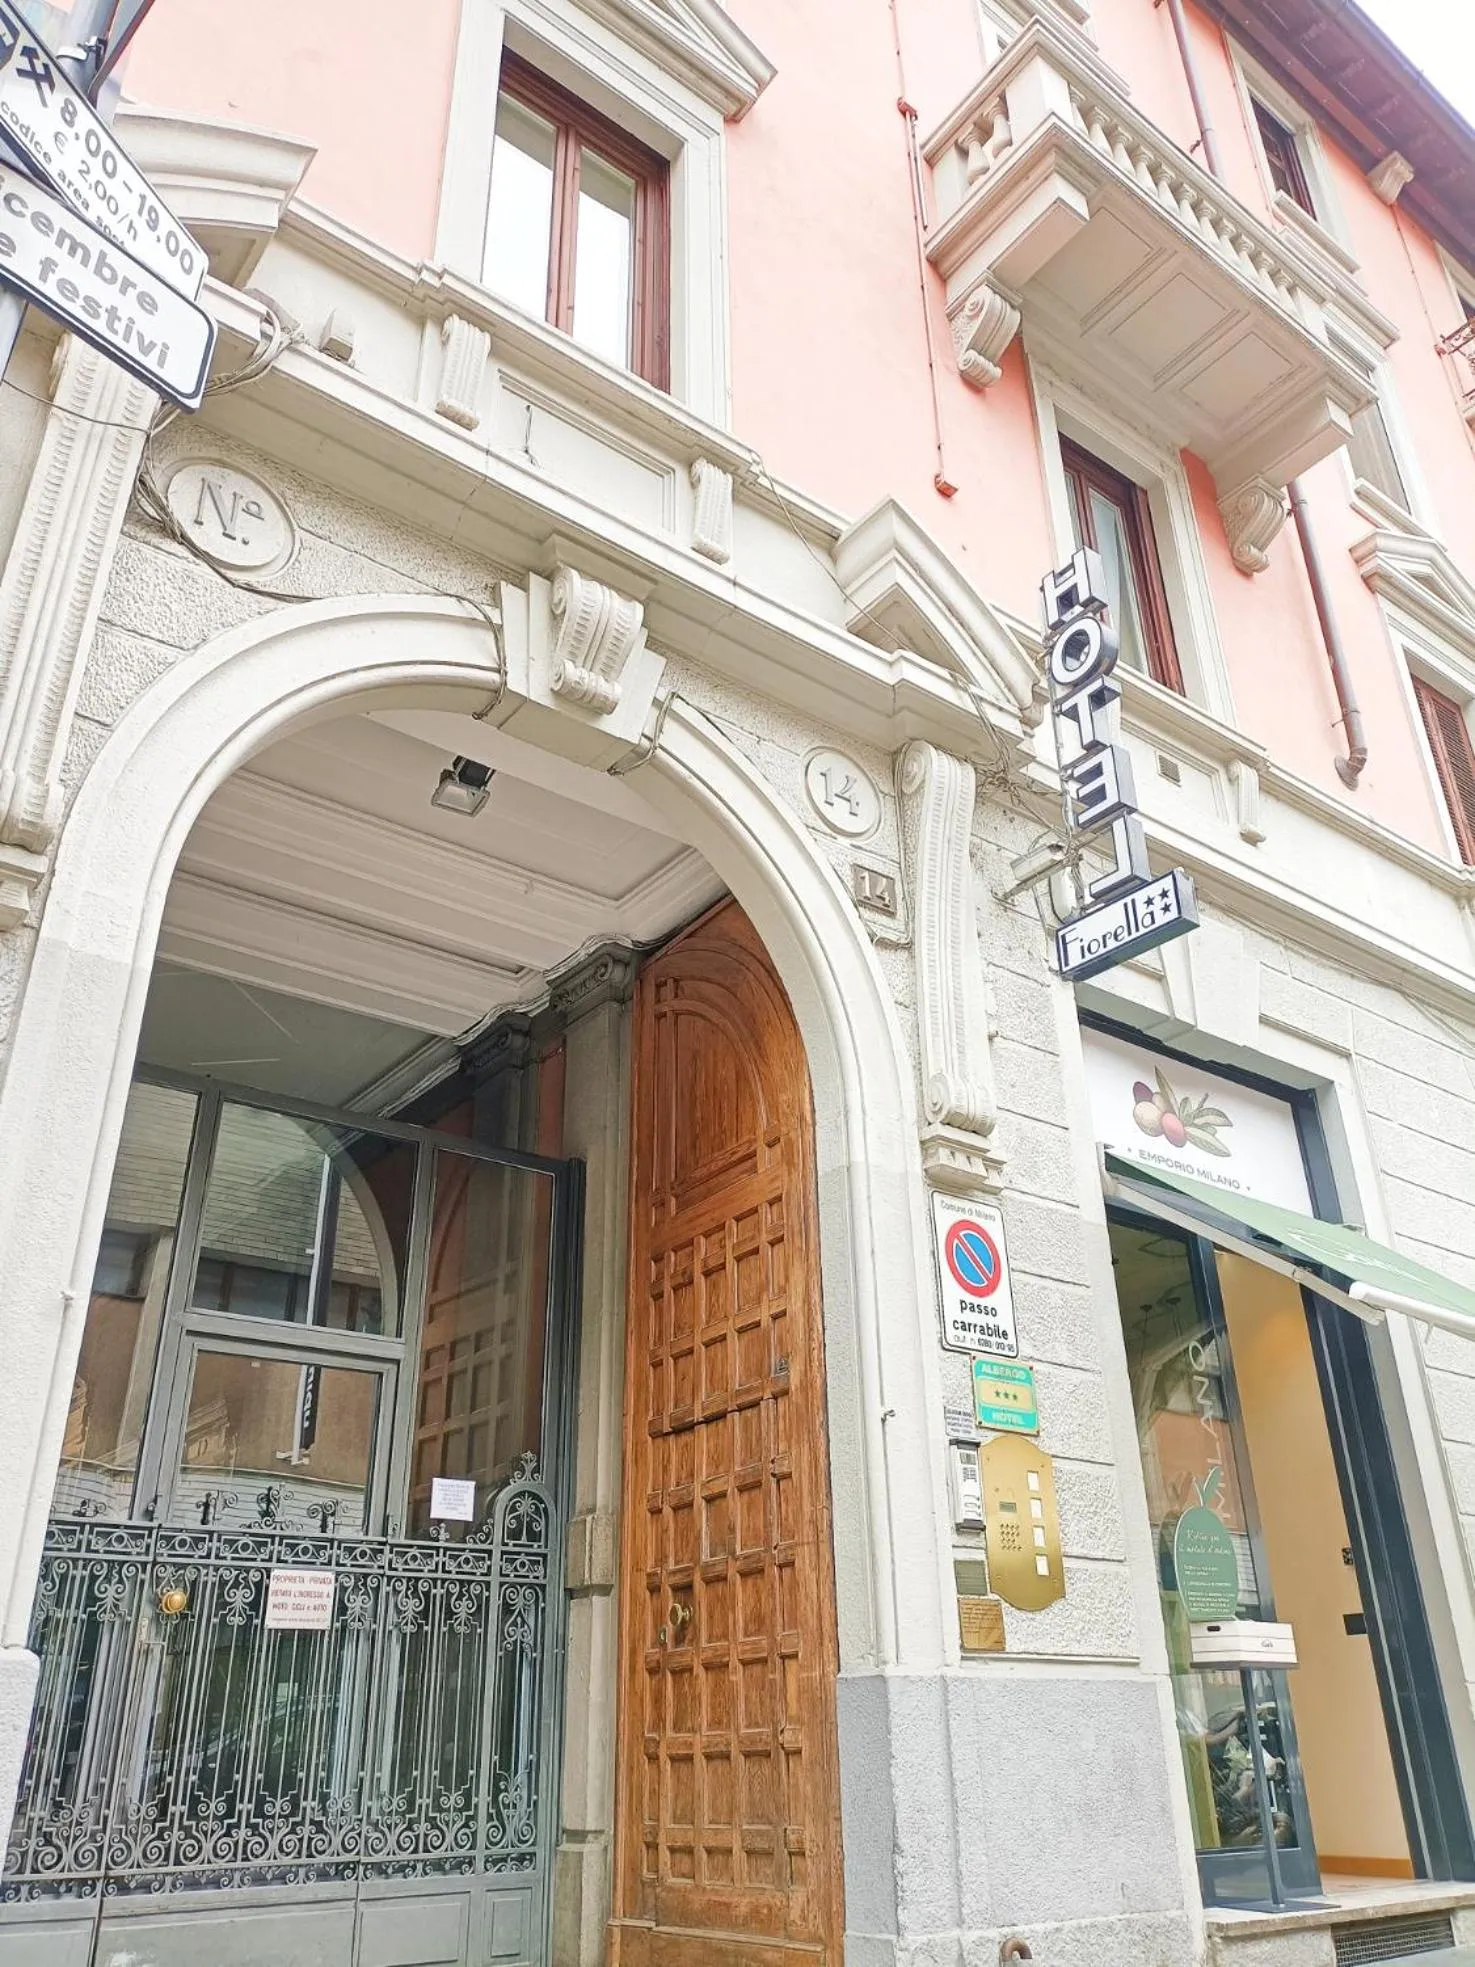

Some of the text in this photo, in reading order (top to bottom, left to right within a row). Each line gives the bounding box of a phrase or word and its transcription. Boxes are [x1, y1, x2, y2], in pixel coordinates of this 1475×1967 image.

[1, 101, 90, 211] codice area
[78, 160, 138, 241] 2,00/h
[38, 256, 170, 369] festivi
[1060, 897, 1157, 971] Fiorella
[1138, 1149, 1241, 1190] EMPORIO MILANO
[952, 1319, 1009, 1341] carrabile
[959, 1299, 997, 1318] passo
